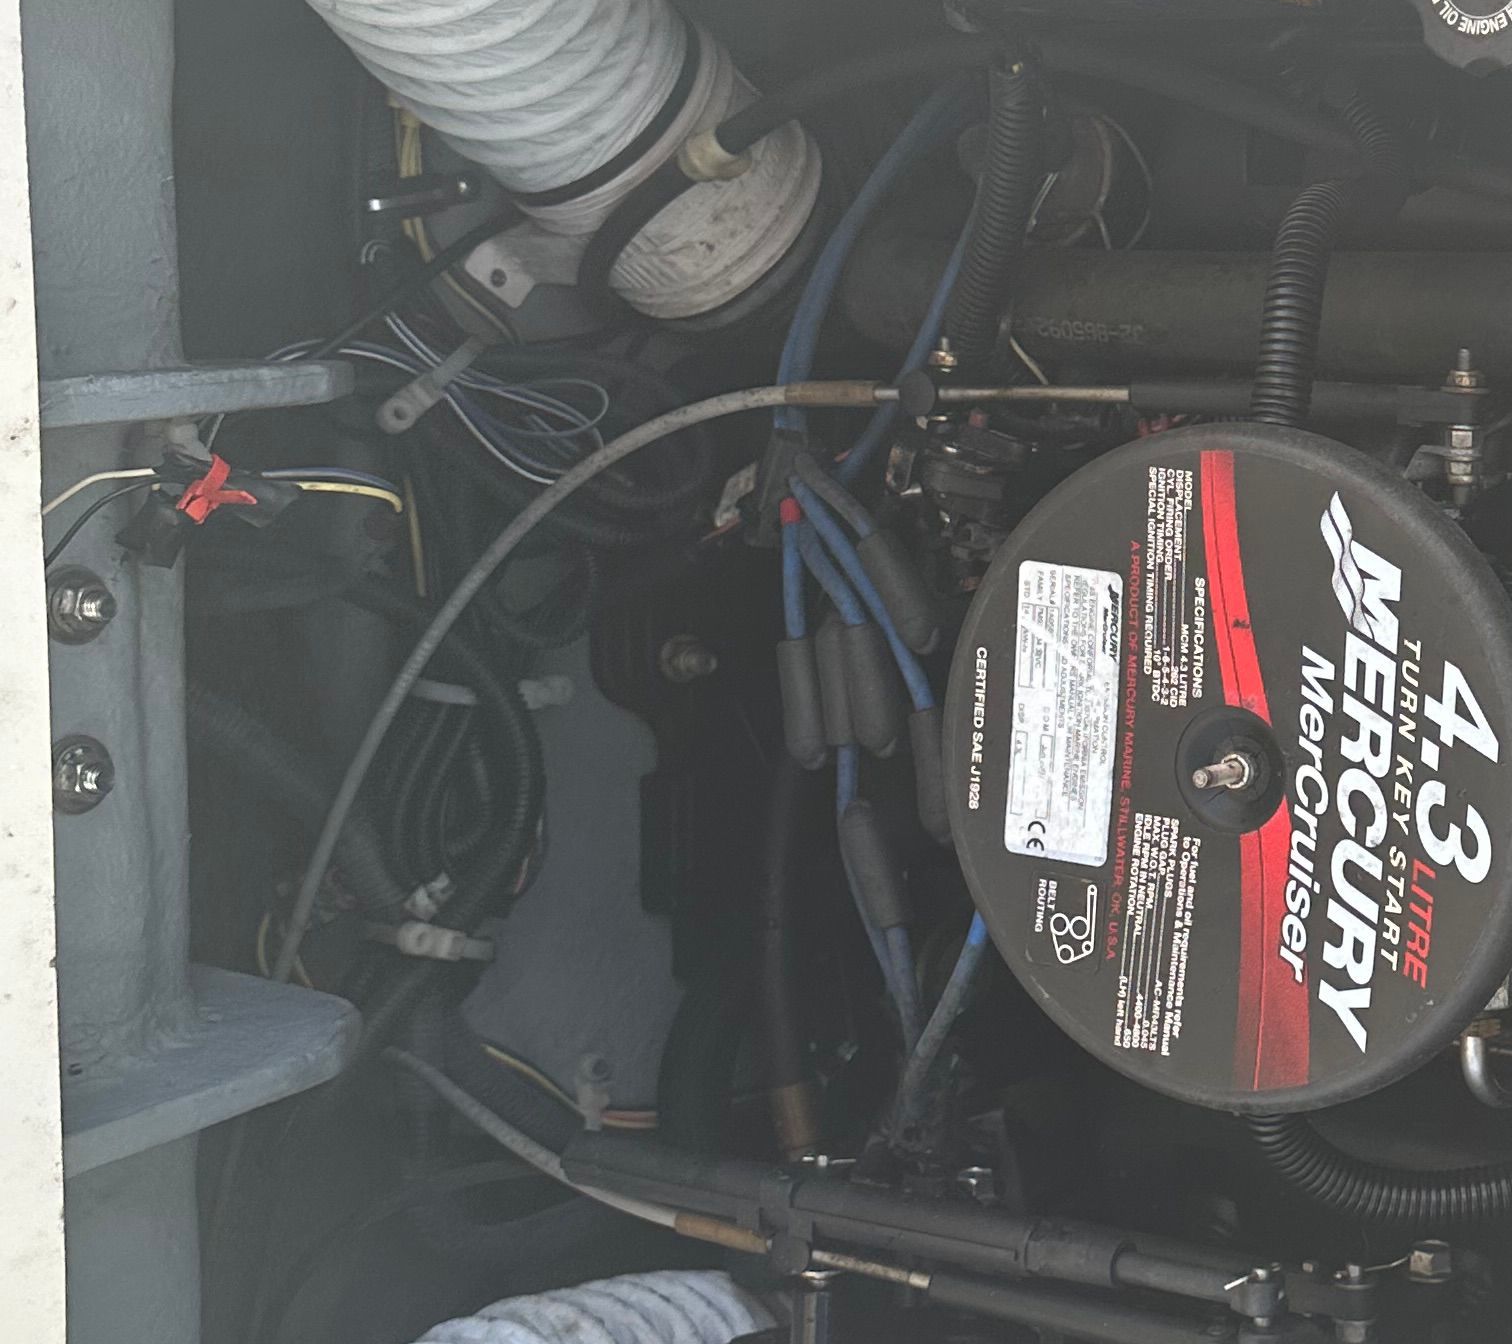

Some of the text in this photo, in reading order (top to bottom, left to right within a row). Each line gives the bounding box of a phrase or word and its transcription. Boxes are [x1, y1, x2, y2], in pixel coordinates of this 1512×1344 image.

[1438, 0, 1459, 25] OIL
[1457, 12, 1508, 35] ENGINE
[1156, 467, 1166, 521] IGNITION
[1165, 497, 1174, 536] FIRING
[1174, 469, 1184, 561] DISPLACEMENT
[1130, 540, 1141, 551] A
[1155, 523, 1165, 564] TIMING
[1164, 539, 1173, 580] ORDER
[1128, 555, 1140, 626] PRODUCT
[1143, 466, 1157, 675] SPECIAL IGNITION TIMING REQUIRED
[1178, 470, 1193, 707] MODEL MCM 4.3 LITRE
[1108, 584, 1119, 662] MERCURY
[1128, 632, 1138, 652] OF
[1192, 577, 1205, 698] SPECIFICATIONS
[1125, 654, 1138, 728] MERCURY
[1152, 669, 1161, 701] BTDC
[1169, 687, 1178, 708] CID
[968, 647, 989, 810] CERTIFIED SAE J1928
[1279, 646, 1335, 983] MerCruiser
[1318, 536, 1402, 1053] MERCURY
[1380, 638, 1422, 971] TURN KEY START
[1143, 814, 1152, 841] IDLE
[1160, 817, 1170, 848] PLUG
[1168, 818, 1179, 857] SPARK
[1402, 659, 1500, 989] 4.3 LITRE
[1139, 871, 1148, 884] IN
[1140, 843, 1150, 869] RPM
[1158, 851, 1167, 876] GAP
[1164, 859, 1176, 898] PLUGS
[1034, 878, 1048, 933] ROUTING
[1047, 881, 1058, 912] BELT
[1134, 885, 1147, 937] NEUTRAL
[1145, 883, 1155, 909] RPM
[1113, 813, 1144, 1047] ENGINE ROTATION (LH) left hand
[1160, 836, 1192, 1056] to Operations & Maintenance Manual
[1171, 837, 1201, 1038] For fuel and oil requirements refer
